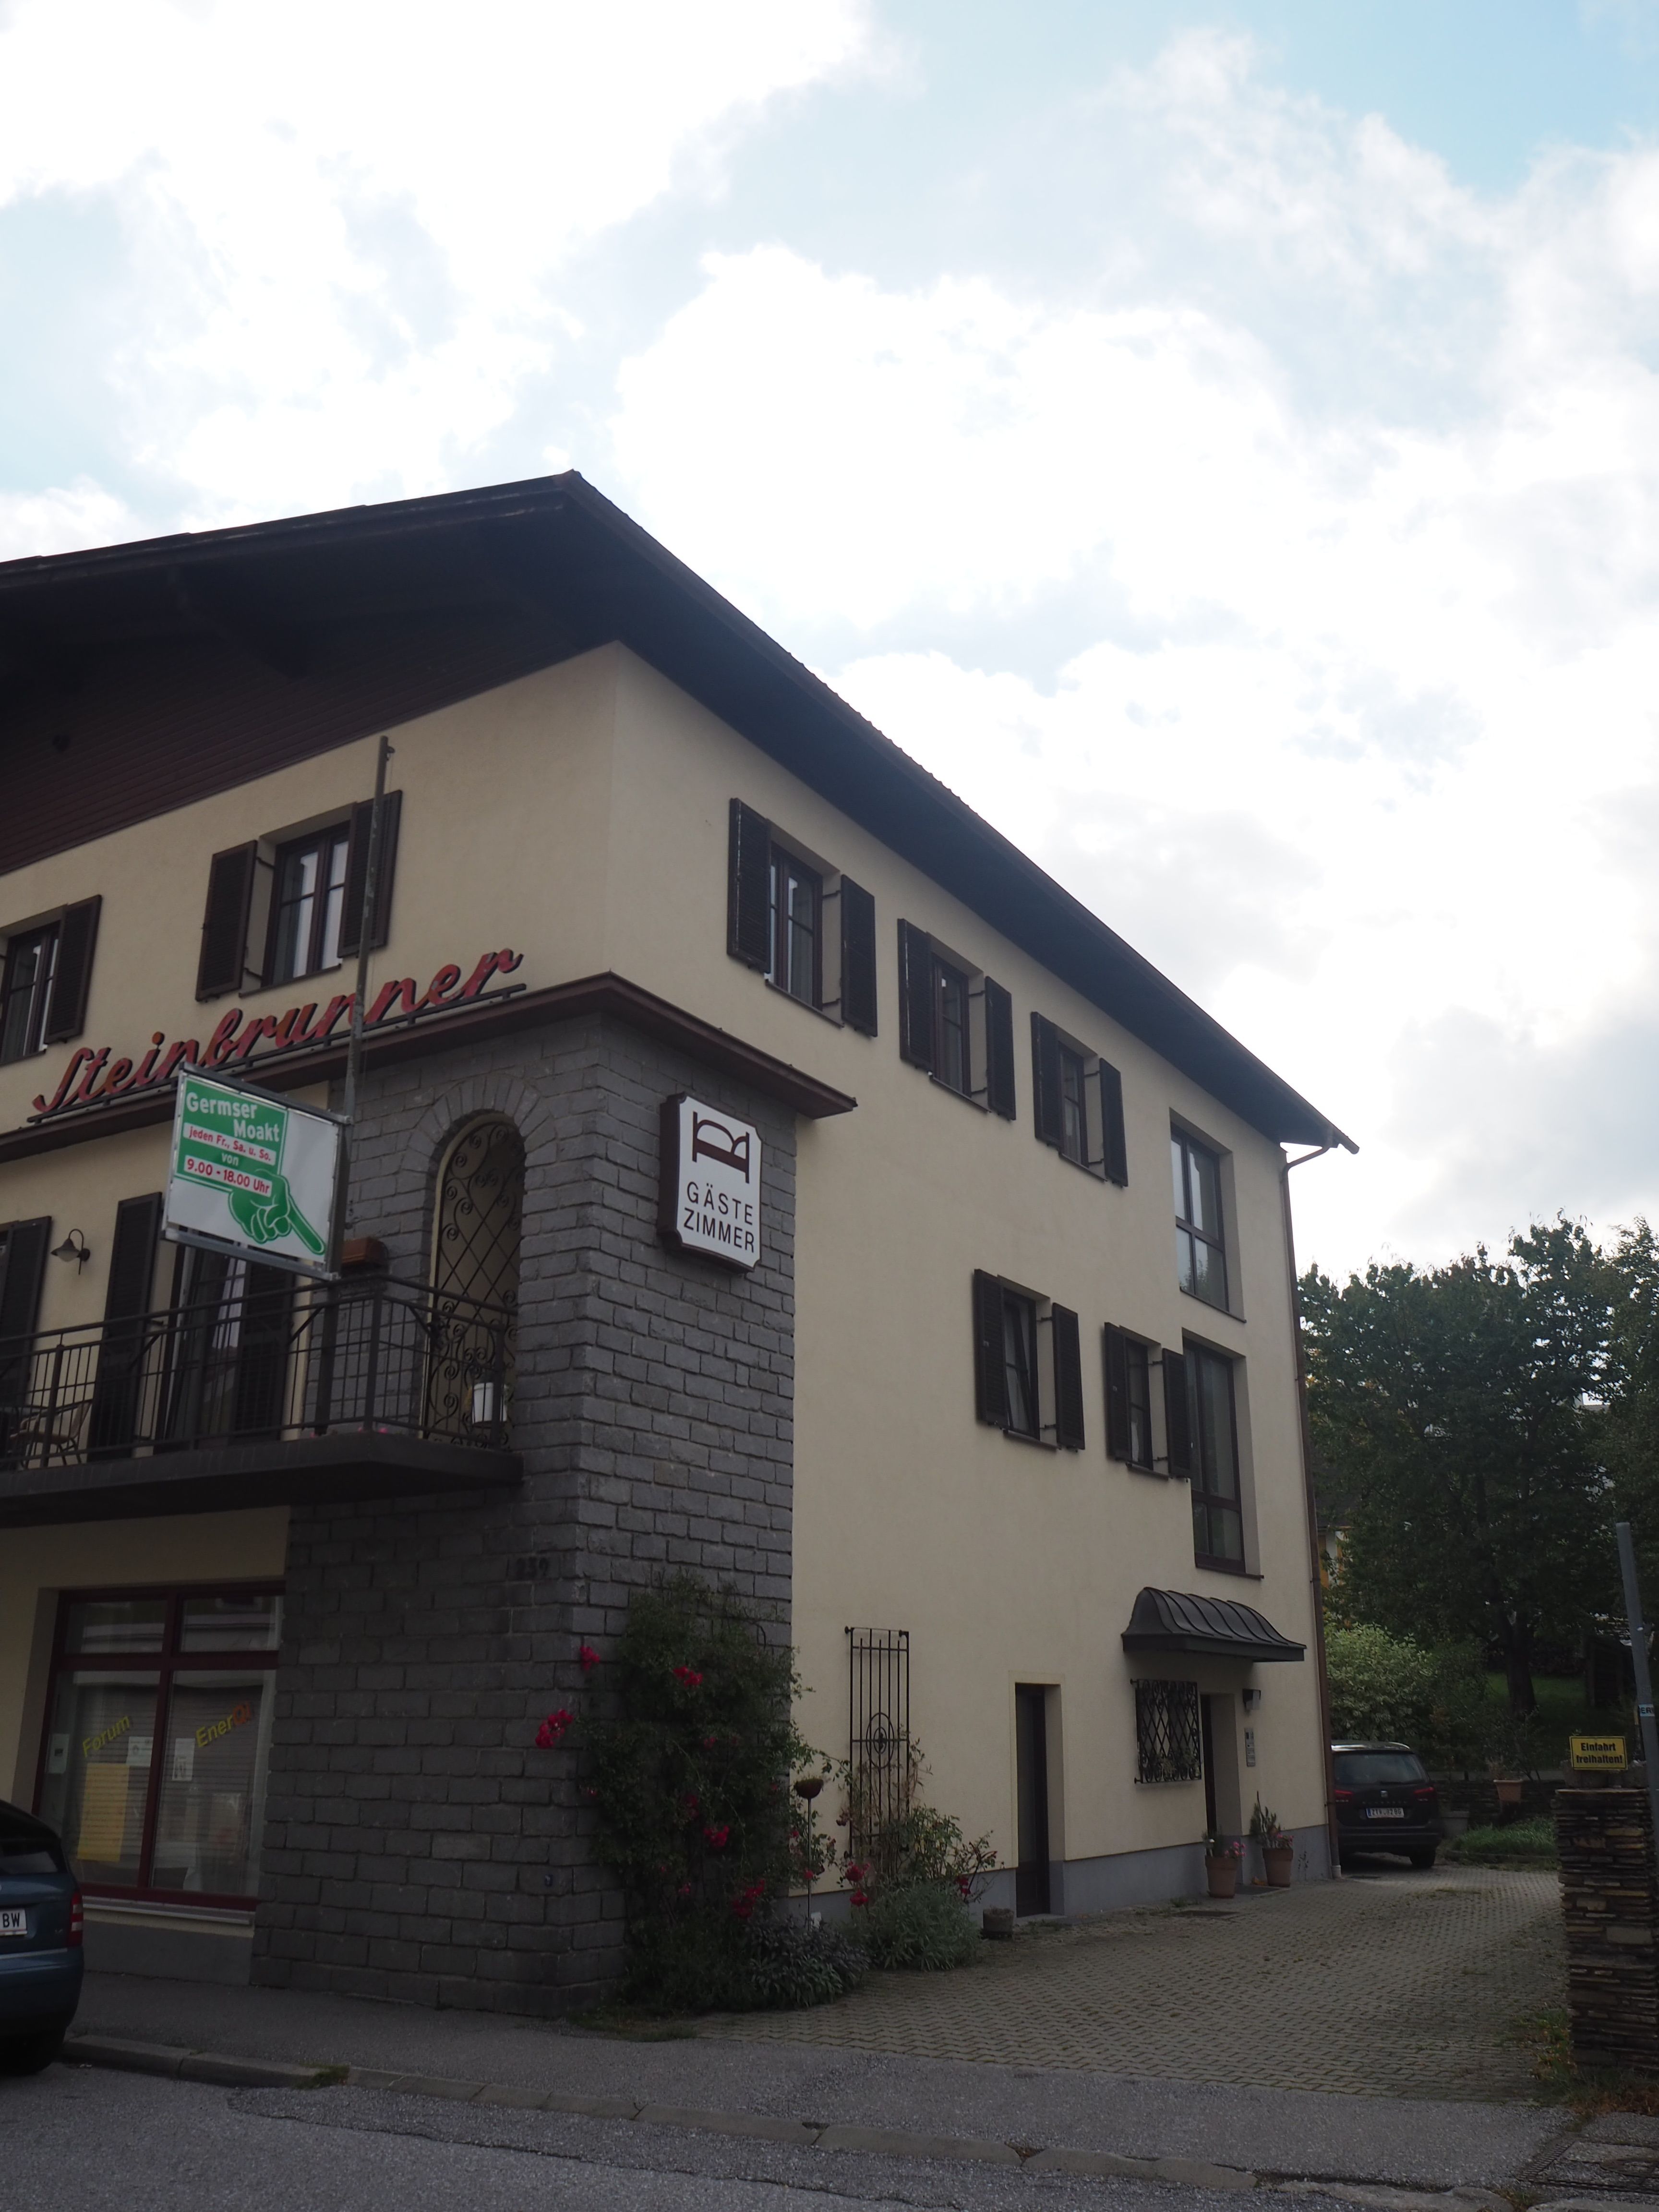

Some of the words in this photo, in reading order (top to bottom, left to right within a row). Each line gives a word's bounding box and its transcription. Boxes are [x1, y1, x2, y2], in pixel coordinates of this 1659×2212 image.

[32, 948, 525, 1114] Steinbrunner
[186, 1092, 257, 1119] Germser
[189, 1126, 213, 1143] jeden
[216, 1134, 230, 1149] Fr.,
[233, 1141, 246, 1153] Sa.
[249, 1147, 256, 1156] u.
[259, 1148, 271, 1162] So.
[233, 1119, 279, 1142] Moakt
[187, 1158, 213, 1176] 9.00
[223, 1169, 250, 1188] 18.00
[253, 1179, 270, 1194] Uhr
[221, 1153, 239, 1166] von
[687, 1181, 753, 1226] GÄSTE
[683, 1207, 754, 1253] ZIMMER
[81, 1715, 131, 1758] Forum
[1580, 1742, 1616, 1752] Einfahrt
[1576, 1755, 1623, 1764] freihalten!
